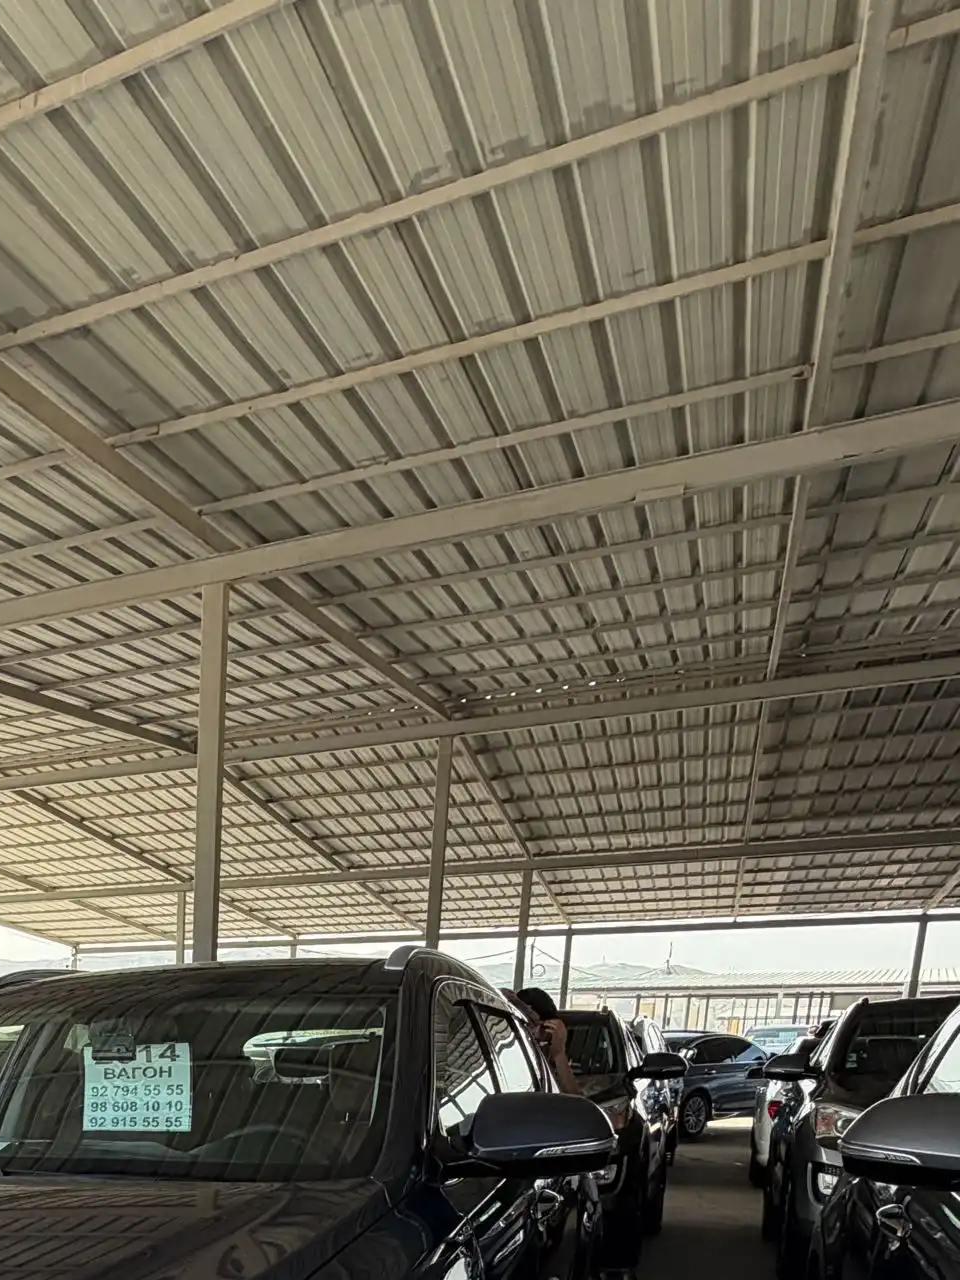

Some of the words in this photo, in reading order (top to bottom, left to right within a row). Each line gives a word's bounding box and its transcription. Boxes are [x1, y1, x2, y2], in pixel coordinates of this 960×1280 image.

[103, 1065, 173, 1080] ВАГОН
[91, 1085, 108, 1097] 92
[113, 1085, 138, 1097] 794
[143, 1084, 161, 1096] 55
[166, 1084, 184, 1096] 55
[90, 1101, 108, 1113] 98
[112, 1101, 138, 1112] 608
[144, 1100, 160, 1112] 10
[167, 1100, 183, 1111] 10
[90, 1117, 107, 1128] 92
[111, 1117, 137, 1128] 915
[142, 1117, 160, 1127] 55
[165, 1116, 183, 1127] 55
